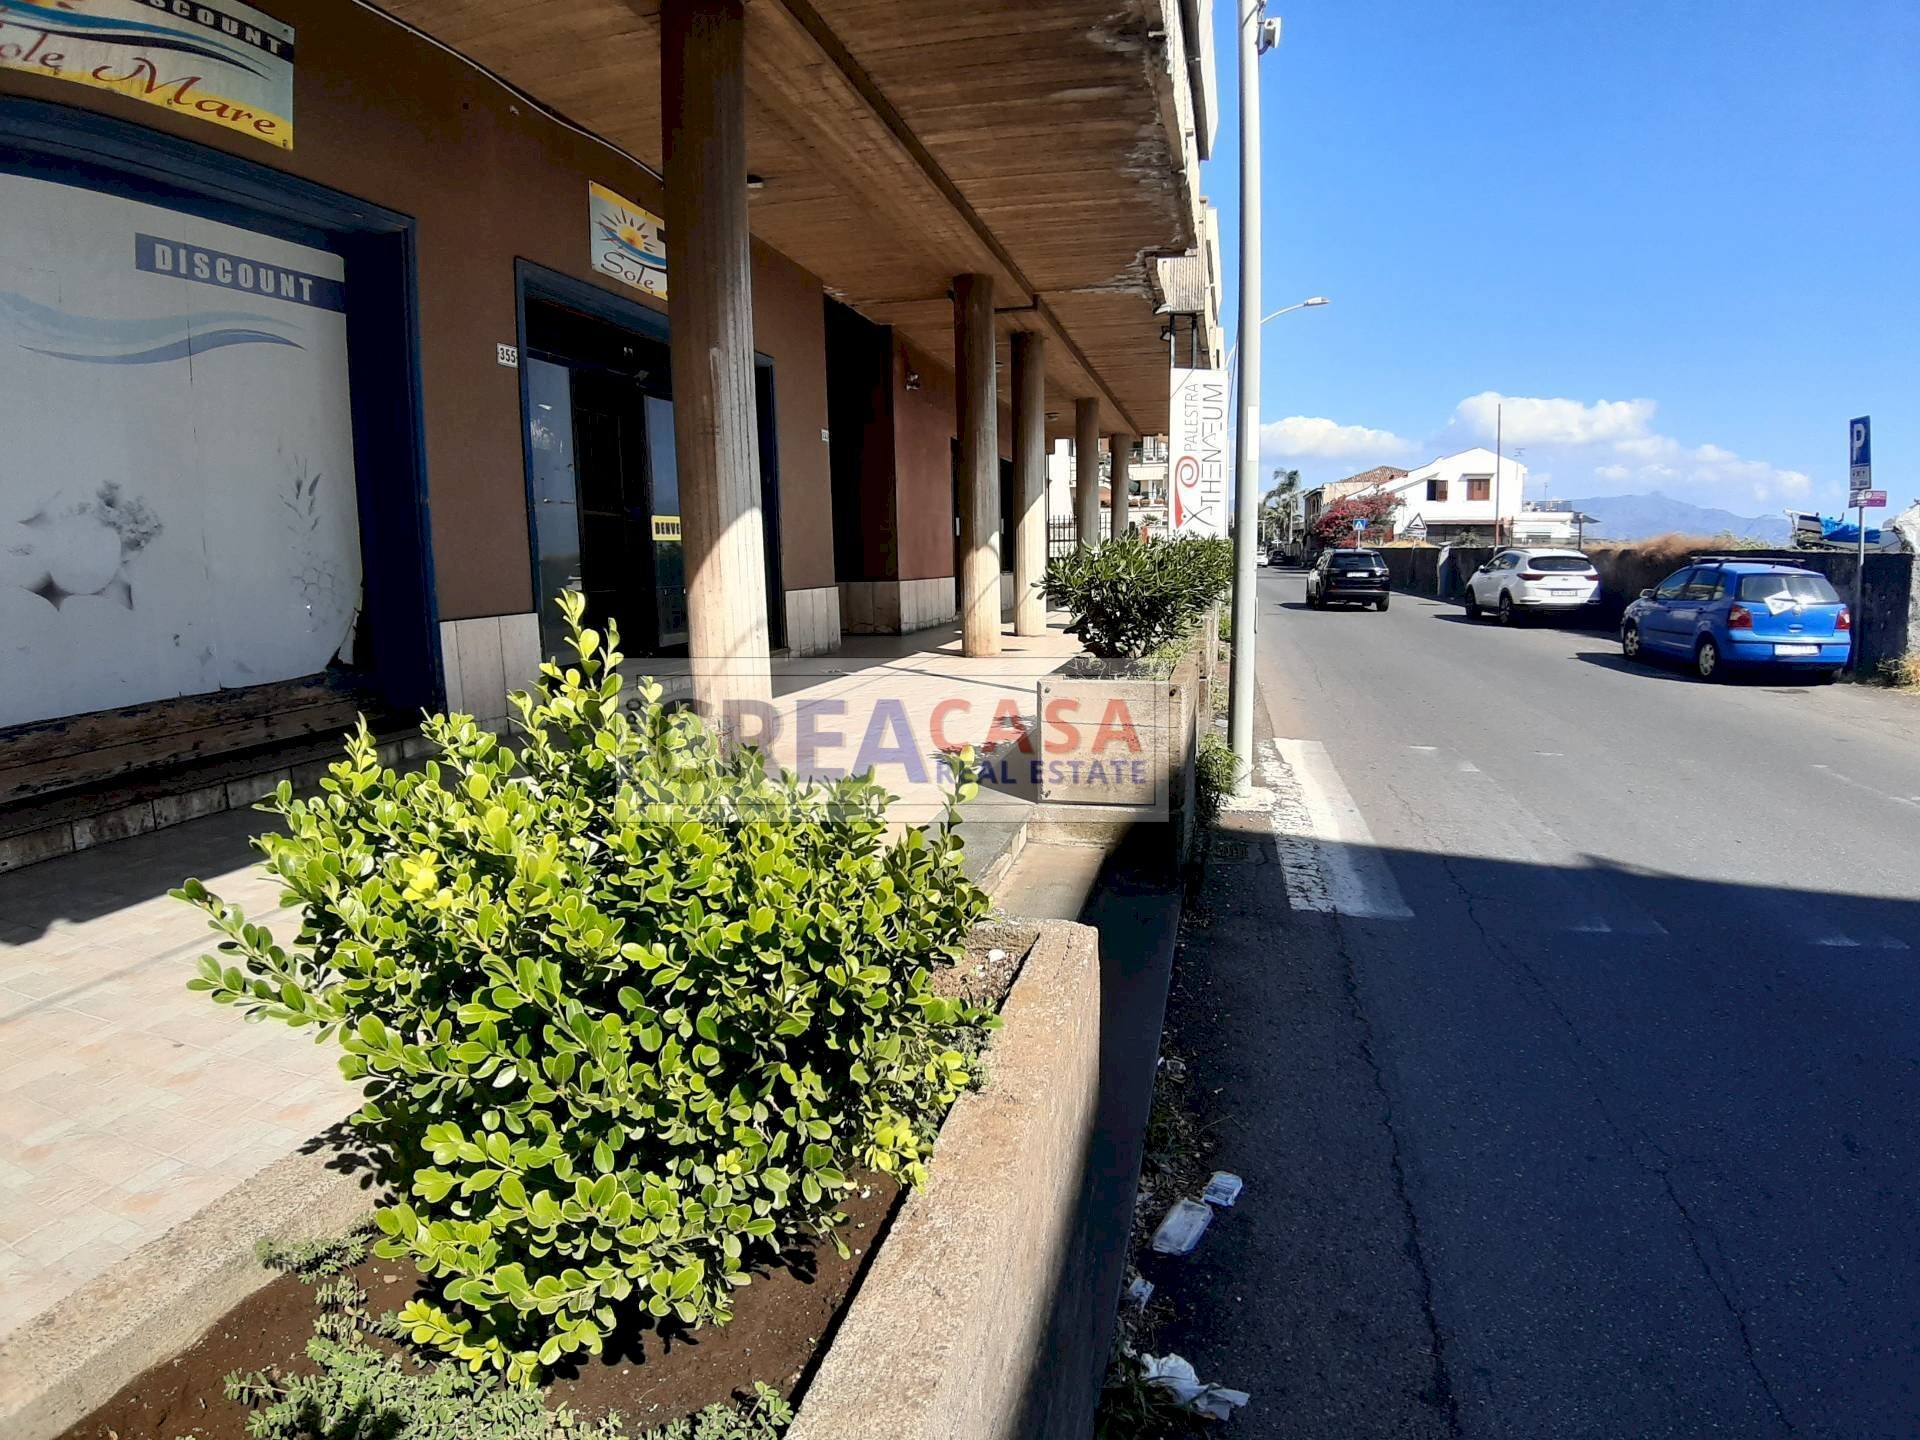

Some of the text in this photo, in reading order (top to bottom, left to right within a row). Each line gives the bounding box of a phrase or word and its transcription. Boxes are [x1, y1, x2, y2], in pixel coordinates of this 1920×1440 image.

[0, 27, 276, 135] ole Mare
[154, 243, 313, 302] DISCOUNT
[601, 251, 655, 290] Sole
[500, 347, 516, 363] 355
[1184, 383, 1199, 452] PALESTRA
[1853, 423, 1866, 462] P
